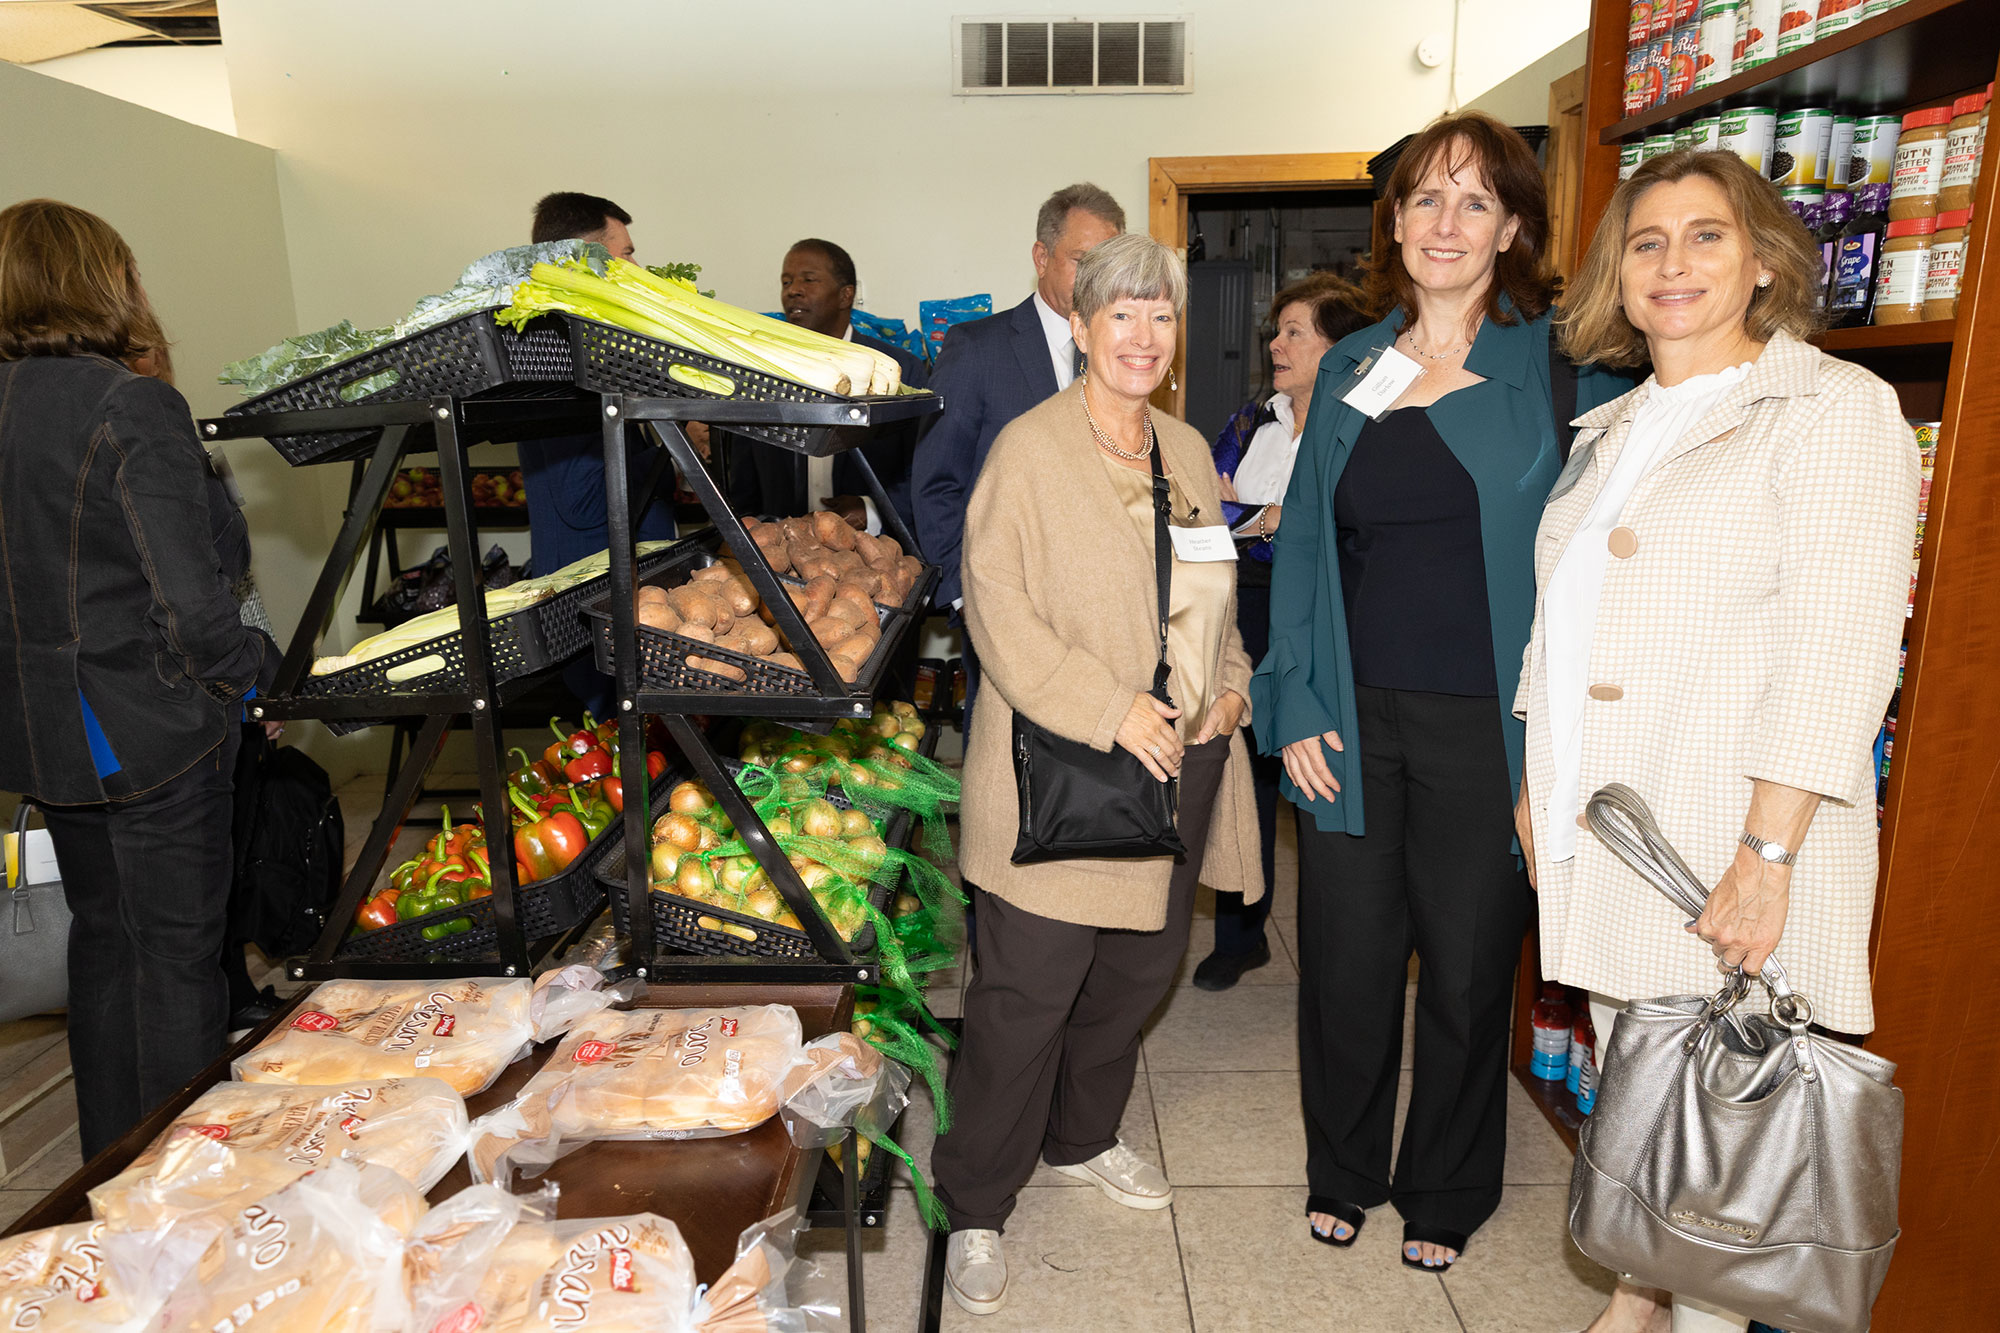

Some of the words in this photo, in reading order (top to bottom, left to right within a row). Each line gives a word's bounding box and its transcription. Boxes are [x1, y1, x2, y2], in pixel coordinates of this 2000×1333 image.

[1896, 147, 1932, 161] NUT'N
[1896, 158, 1931, 170] BETTER
[1840, 256, 1862, 268] Grape
